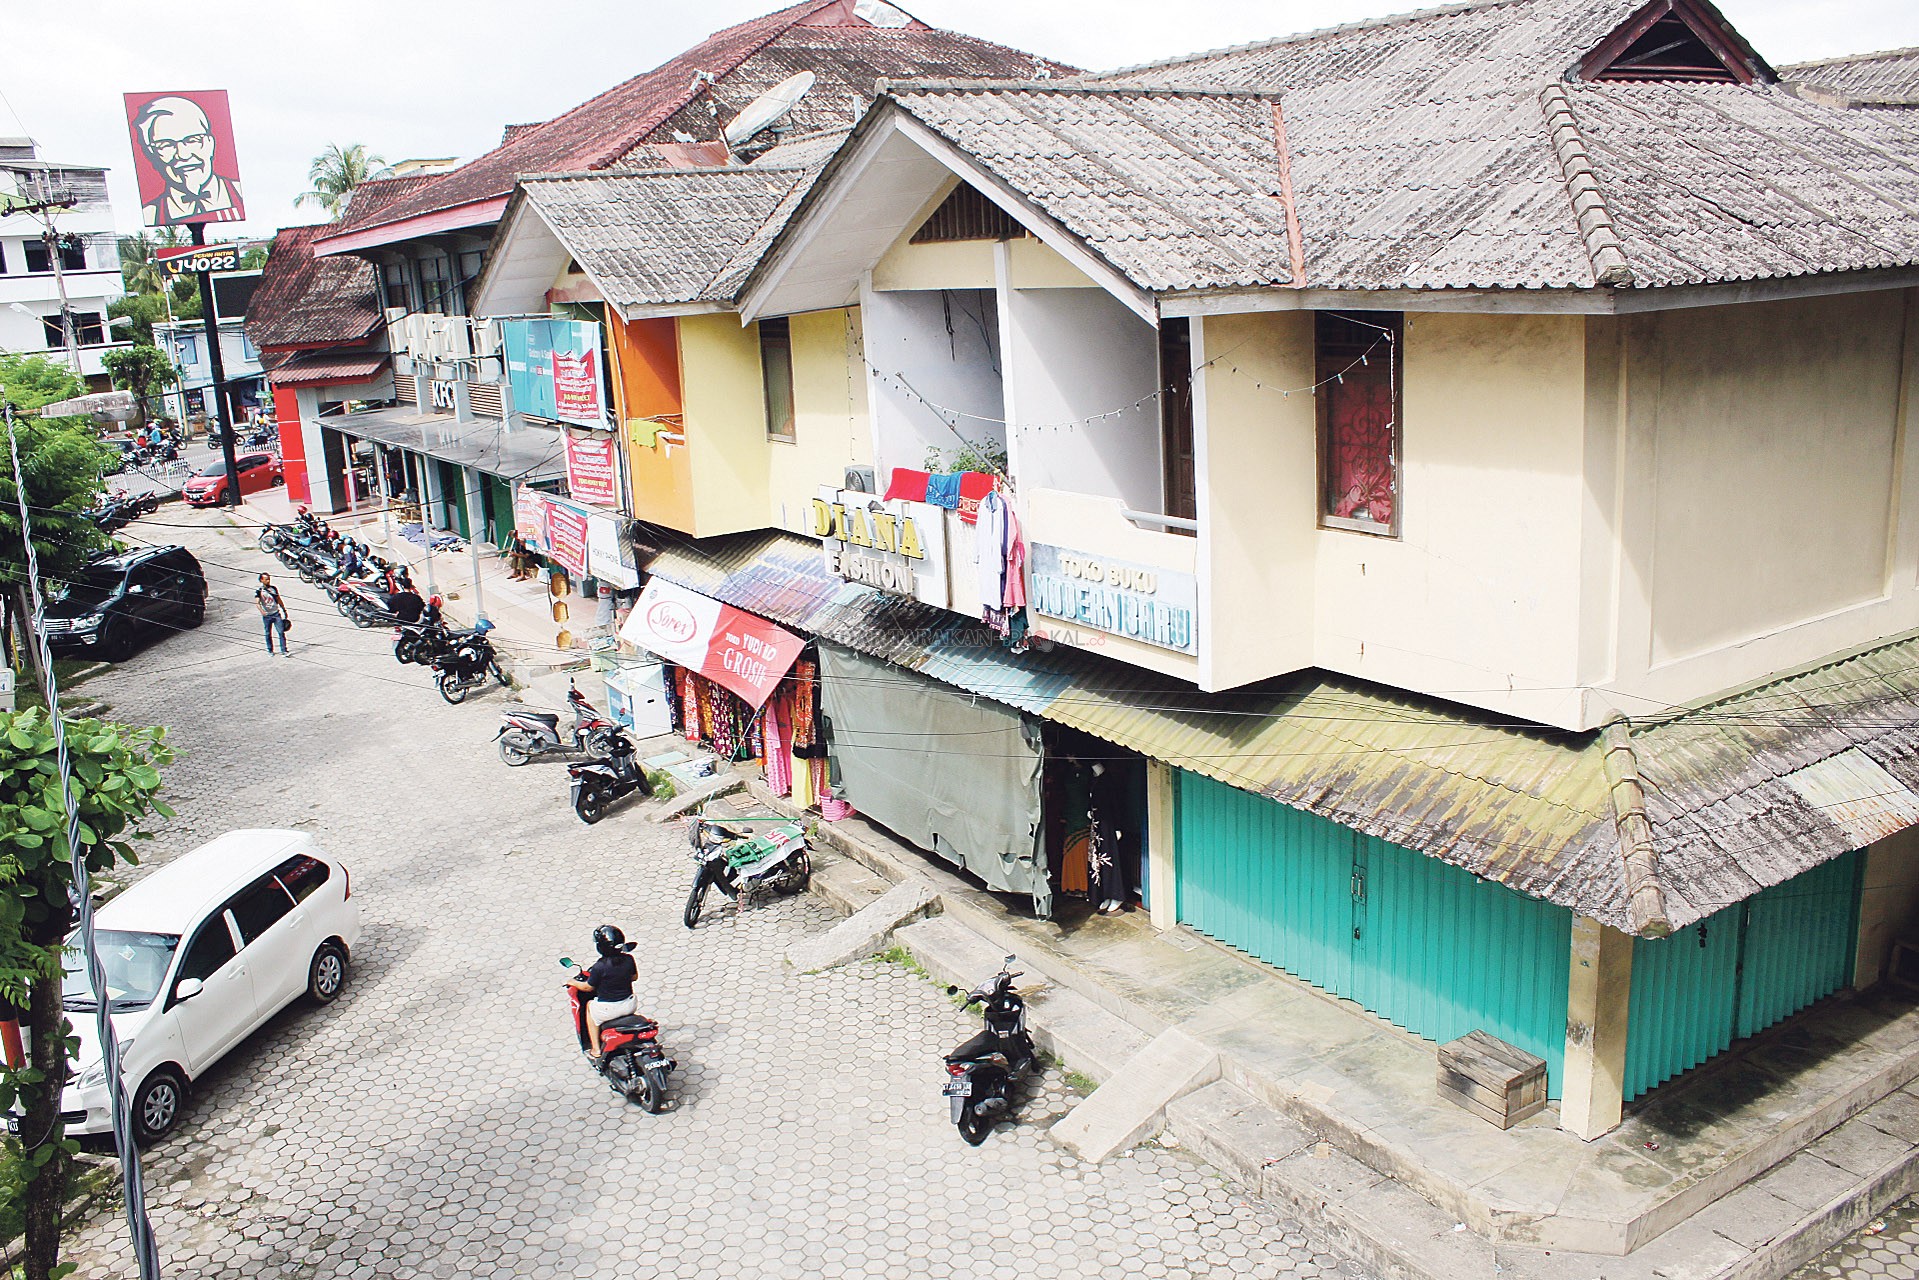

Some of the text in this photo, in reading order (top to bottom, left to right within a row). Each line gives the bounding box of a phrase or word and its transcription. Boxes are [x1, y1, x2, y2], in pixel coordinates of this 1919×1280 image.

[176, 256, 236, 273] 14022
[431, 380, 455, 408] KFC
[812, 497, 925, 560] DIANA
[830, 549, 916, 595] FASHION
[1058, 553, 1158, 594] TOKO BUKU
[651, 605, 688, 635] Sorex
[1031, 573, 1123, 632] MODERN
[742, 633, 764, 656] YUDI
